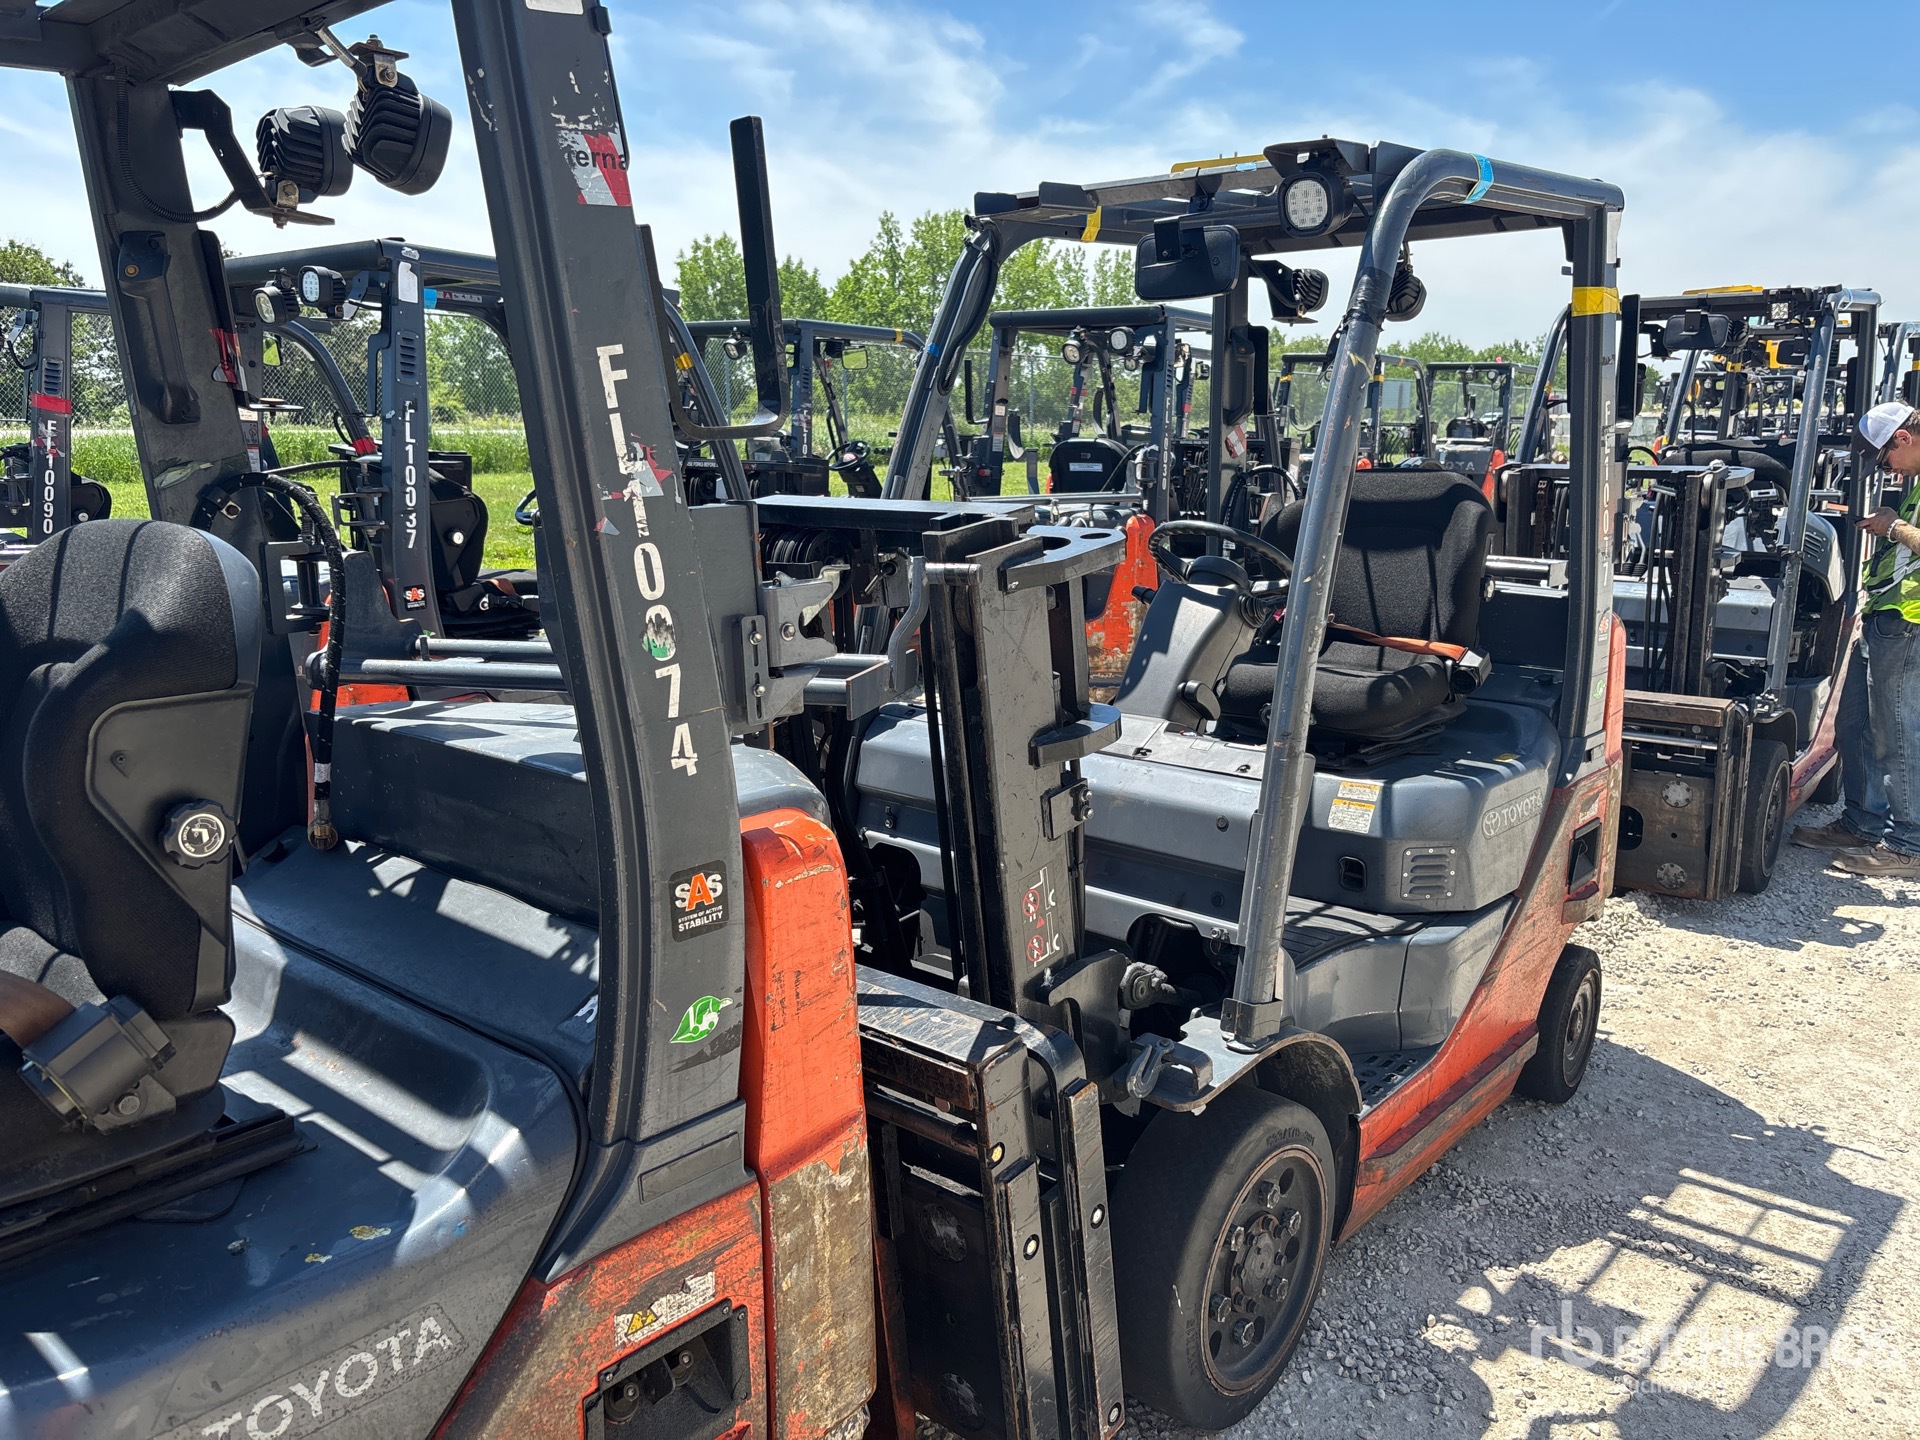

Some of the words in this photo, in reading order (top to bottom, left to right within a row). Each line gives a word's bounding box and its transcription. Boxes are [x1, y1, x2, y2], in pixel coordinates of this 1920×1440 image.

[405, 587, 425, 602] SAS
[1501, 791, 1543, 826] TOYOTA
[675, 872, 723, 912] SAS
[678, 913, 698, 923] SYSTEM
[706, 905, 723, 915] ACTIVE
[678, 911, 723, 932] STABILITY
[200, 1315, 454, 1440] TOYOTA
